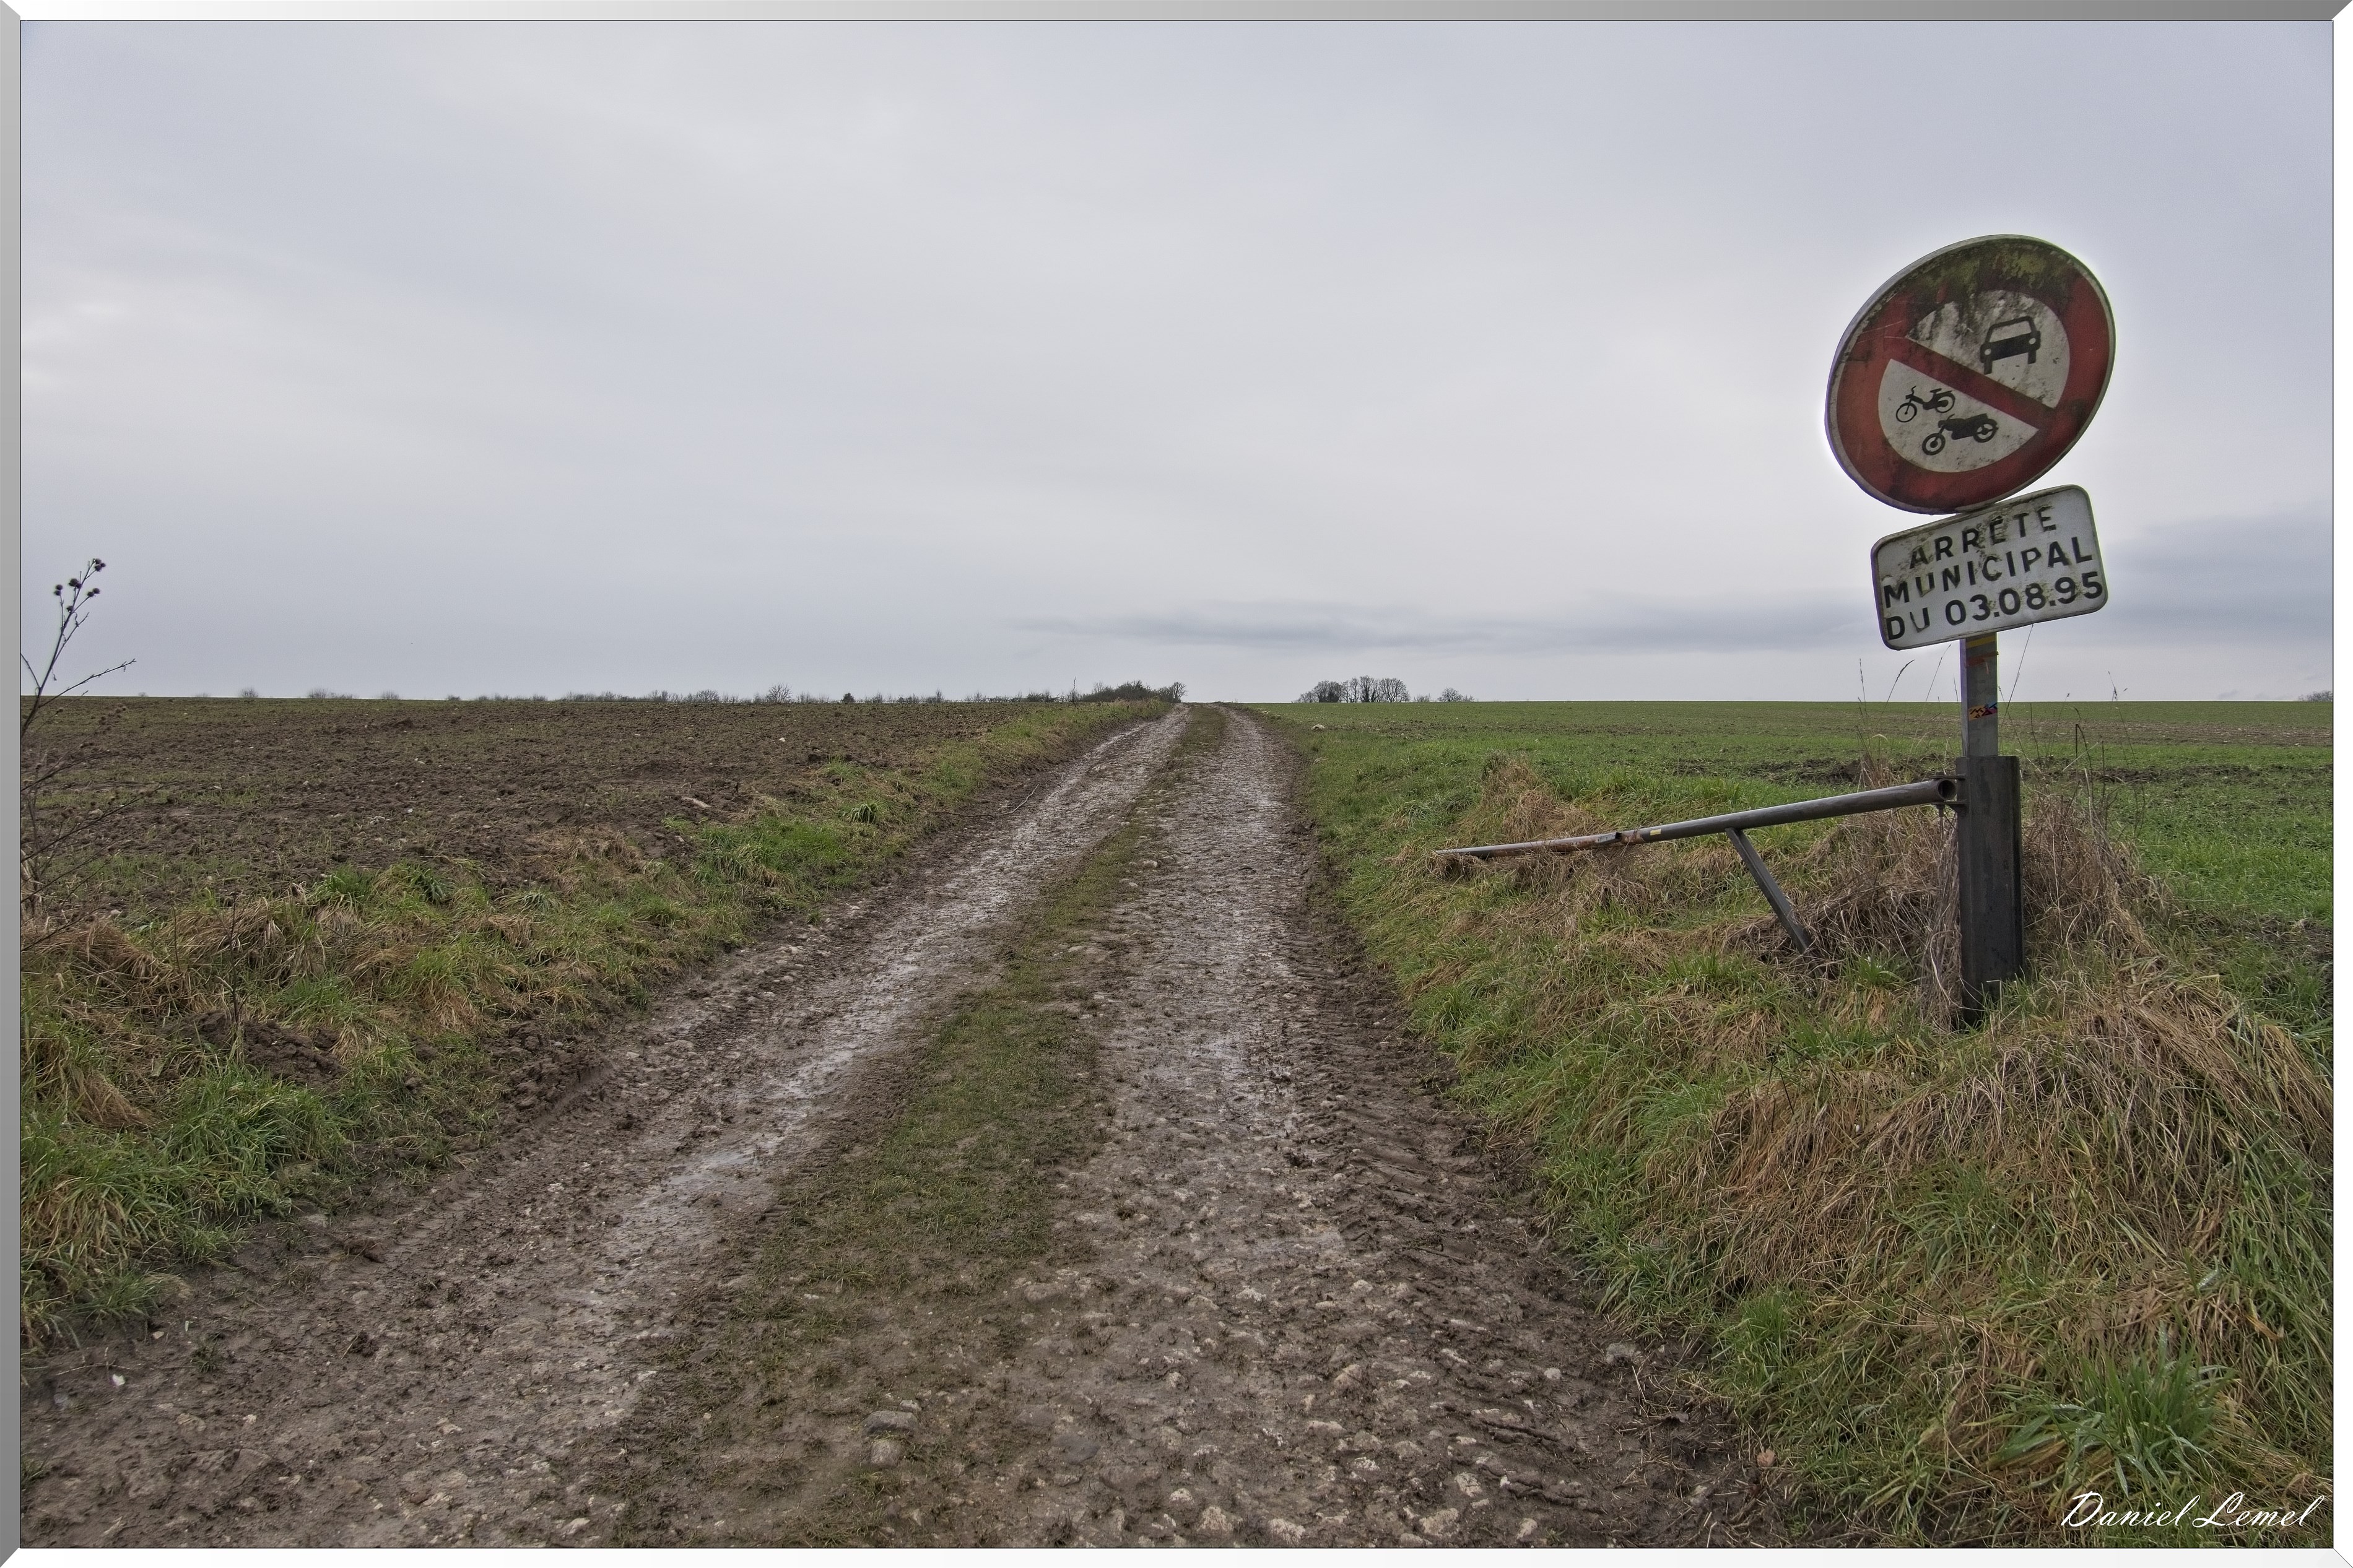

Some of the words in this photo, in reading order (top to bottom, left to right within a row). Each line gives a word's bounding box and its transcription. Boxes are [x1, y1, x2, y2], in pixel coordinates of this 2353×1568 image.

[1883, 536, 2093, 609] MUNICIPAL
[1887, 607, 1931, 640] DU
[1945, 571, 2103, 626] 03.08.95
